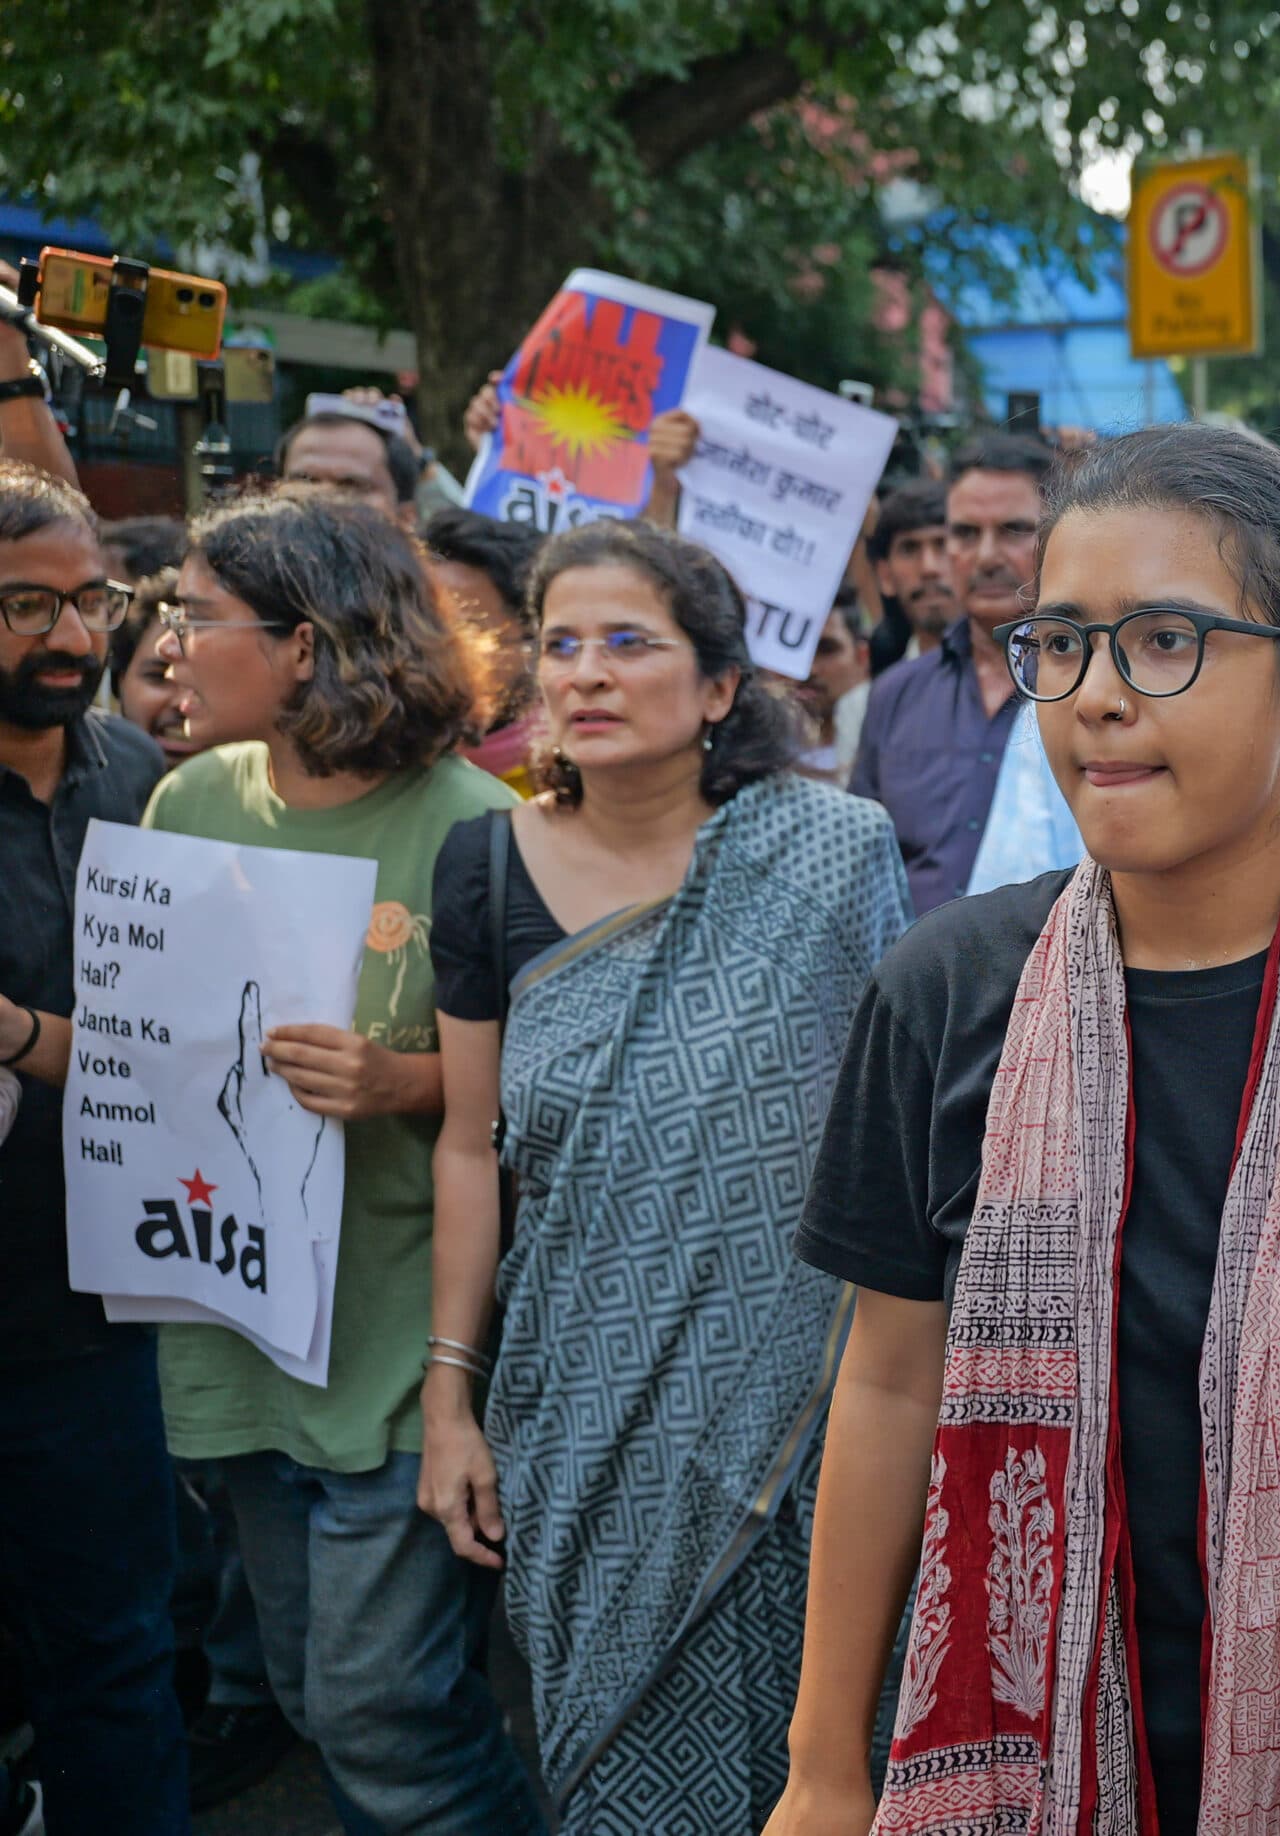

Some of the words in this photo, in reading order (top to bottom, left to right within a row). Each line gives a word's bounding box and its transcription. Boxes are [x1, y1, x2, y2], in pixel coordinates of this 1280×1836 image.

[86, 867, 138, 900] Kursi
[143, 878, 171, 906] Ka
[83, 913, 119, 948] Kya
[128, 923, 164, 951] Mol
[81, 960, 121, 989] Hai?
[78, 1006, 132, 1038] Janta
[141, 1018, 171, 1045] Ka
[78, 1050, 131, 1078] Vote
[80, 1095, 155, 1124] Anmol
[80, 1138, 123, 1166] Hai!
[135, 1168, 267, 1294] aisa
